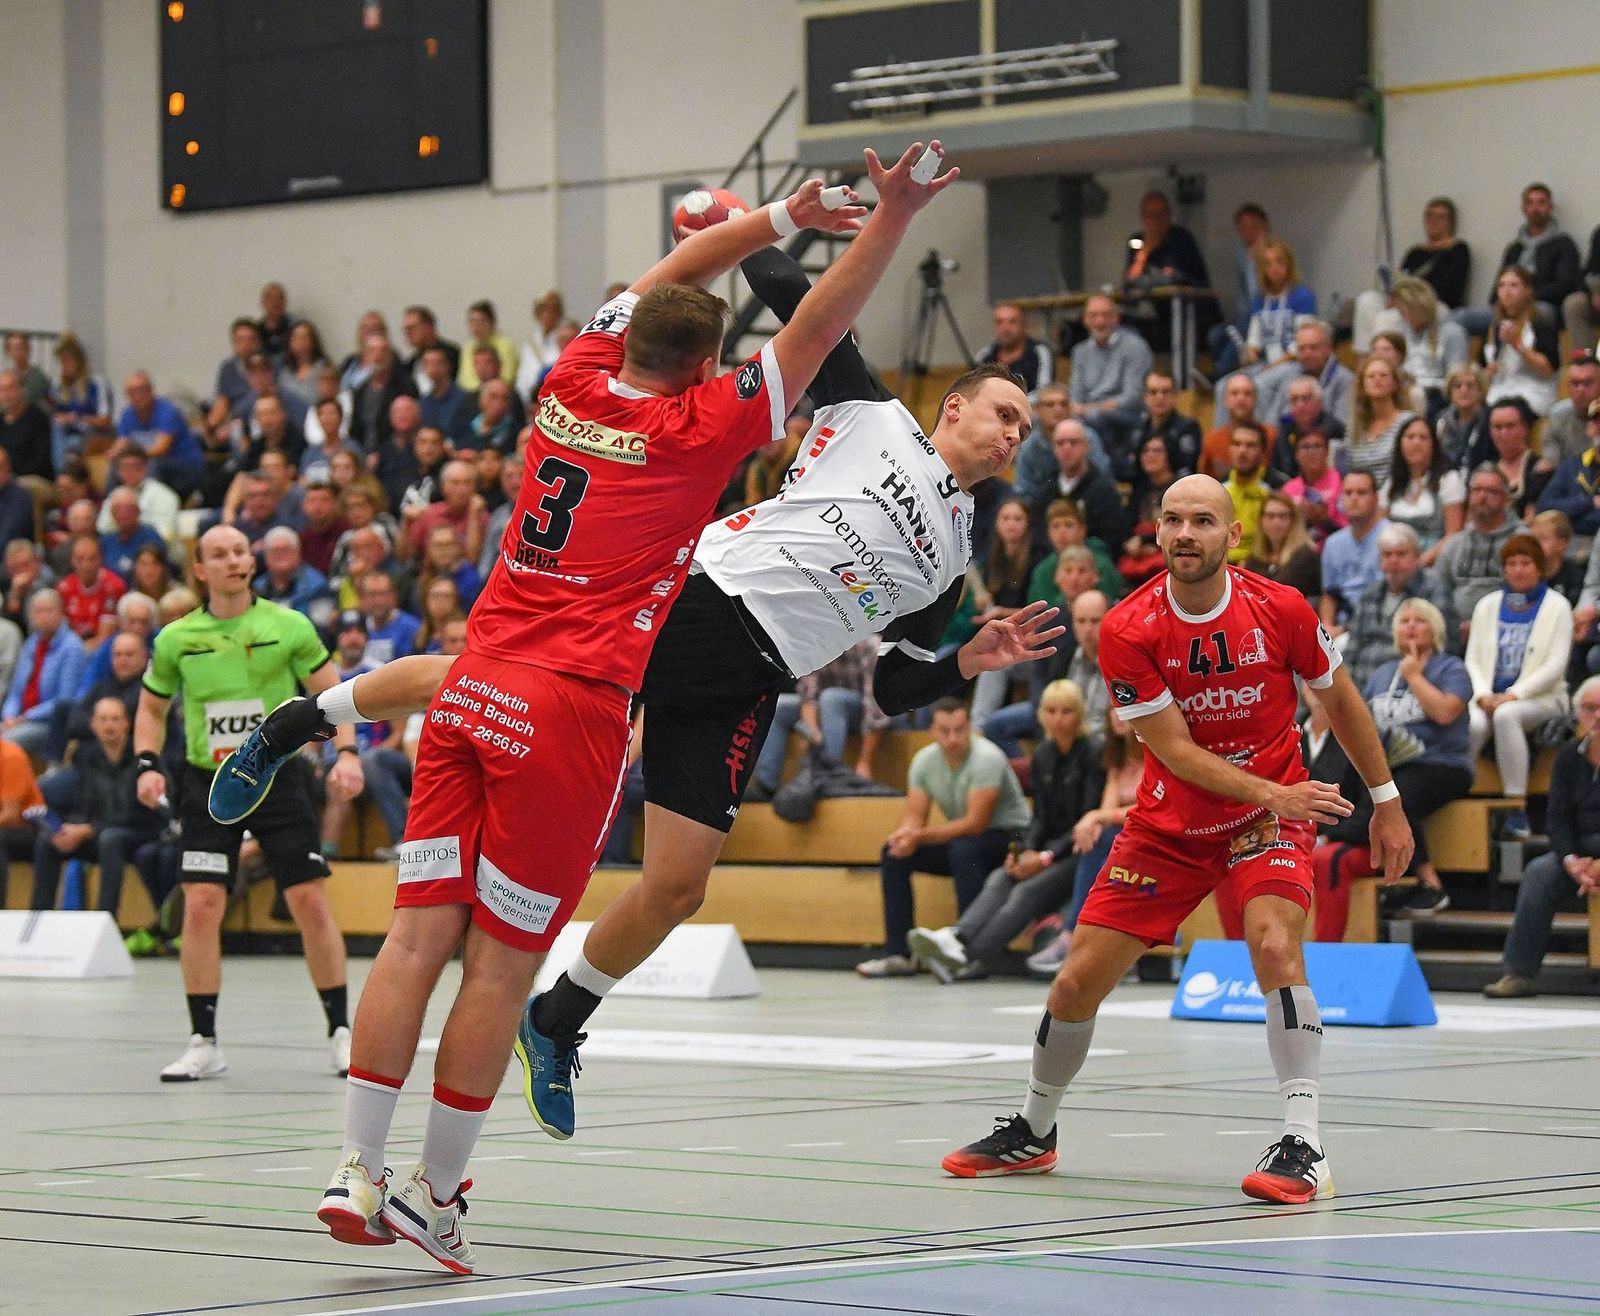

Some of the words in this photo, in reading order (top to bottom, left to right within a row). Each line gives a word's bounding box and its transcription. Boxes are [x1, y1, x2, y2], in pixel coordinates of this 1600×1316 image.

[608, 435, 647, 452] AG
[912, 430, 936, 456] JAKO
[521, 455, 591, 553] 3
[1187, 630, 1236, 678] 41
[456, 675, 529, 714] Architektin
[440, 688, 482, 713] Sabine
[484, 703, 535, 738] Brauch
[1197, 712, 1224, 724] your
[1226, 708, 1251, 721] side
[400, 846, 458, 867] KLEPIOS
[1268, 857, 1296, 869] JAKO
[488, 890, 548, 926] Seligenstadt
[491, 880, 553, 914] SPORTKLINIK
[1286, 1092, 1313, 1100] JAKO
